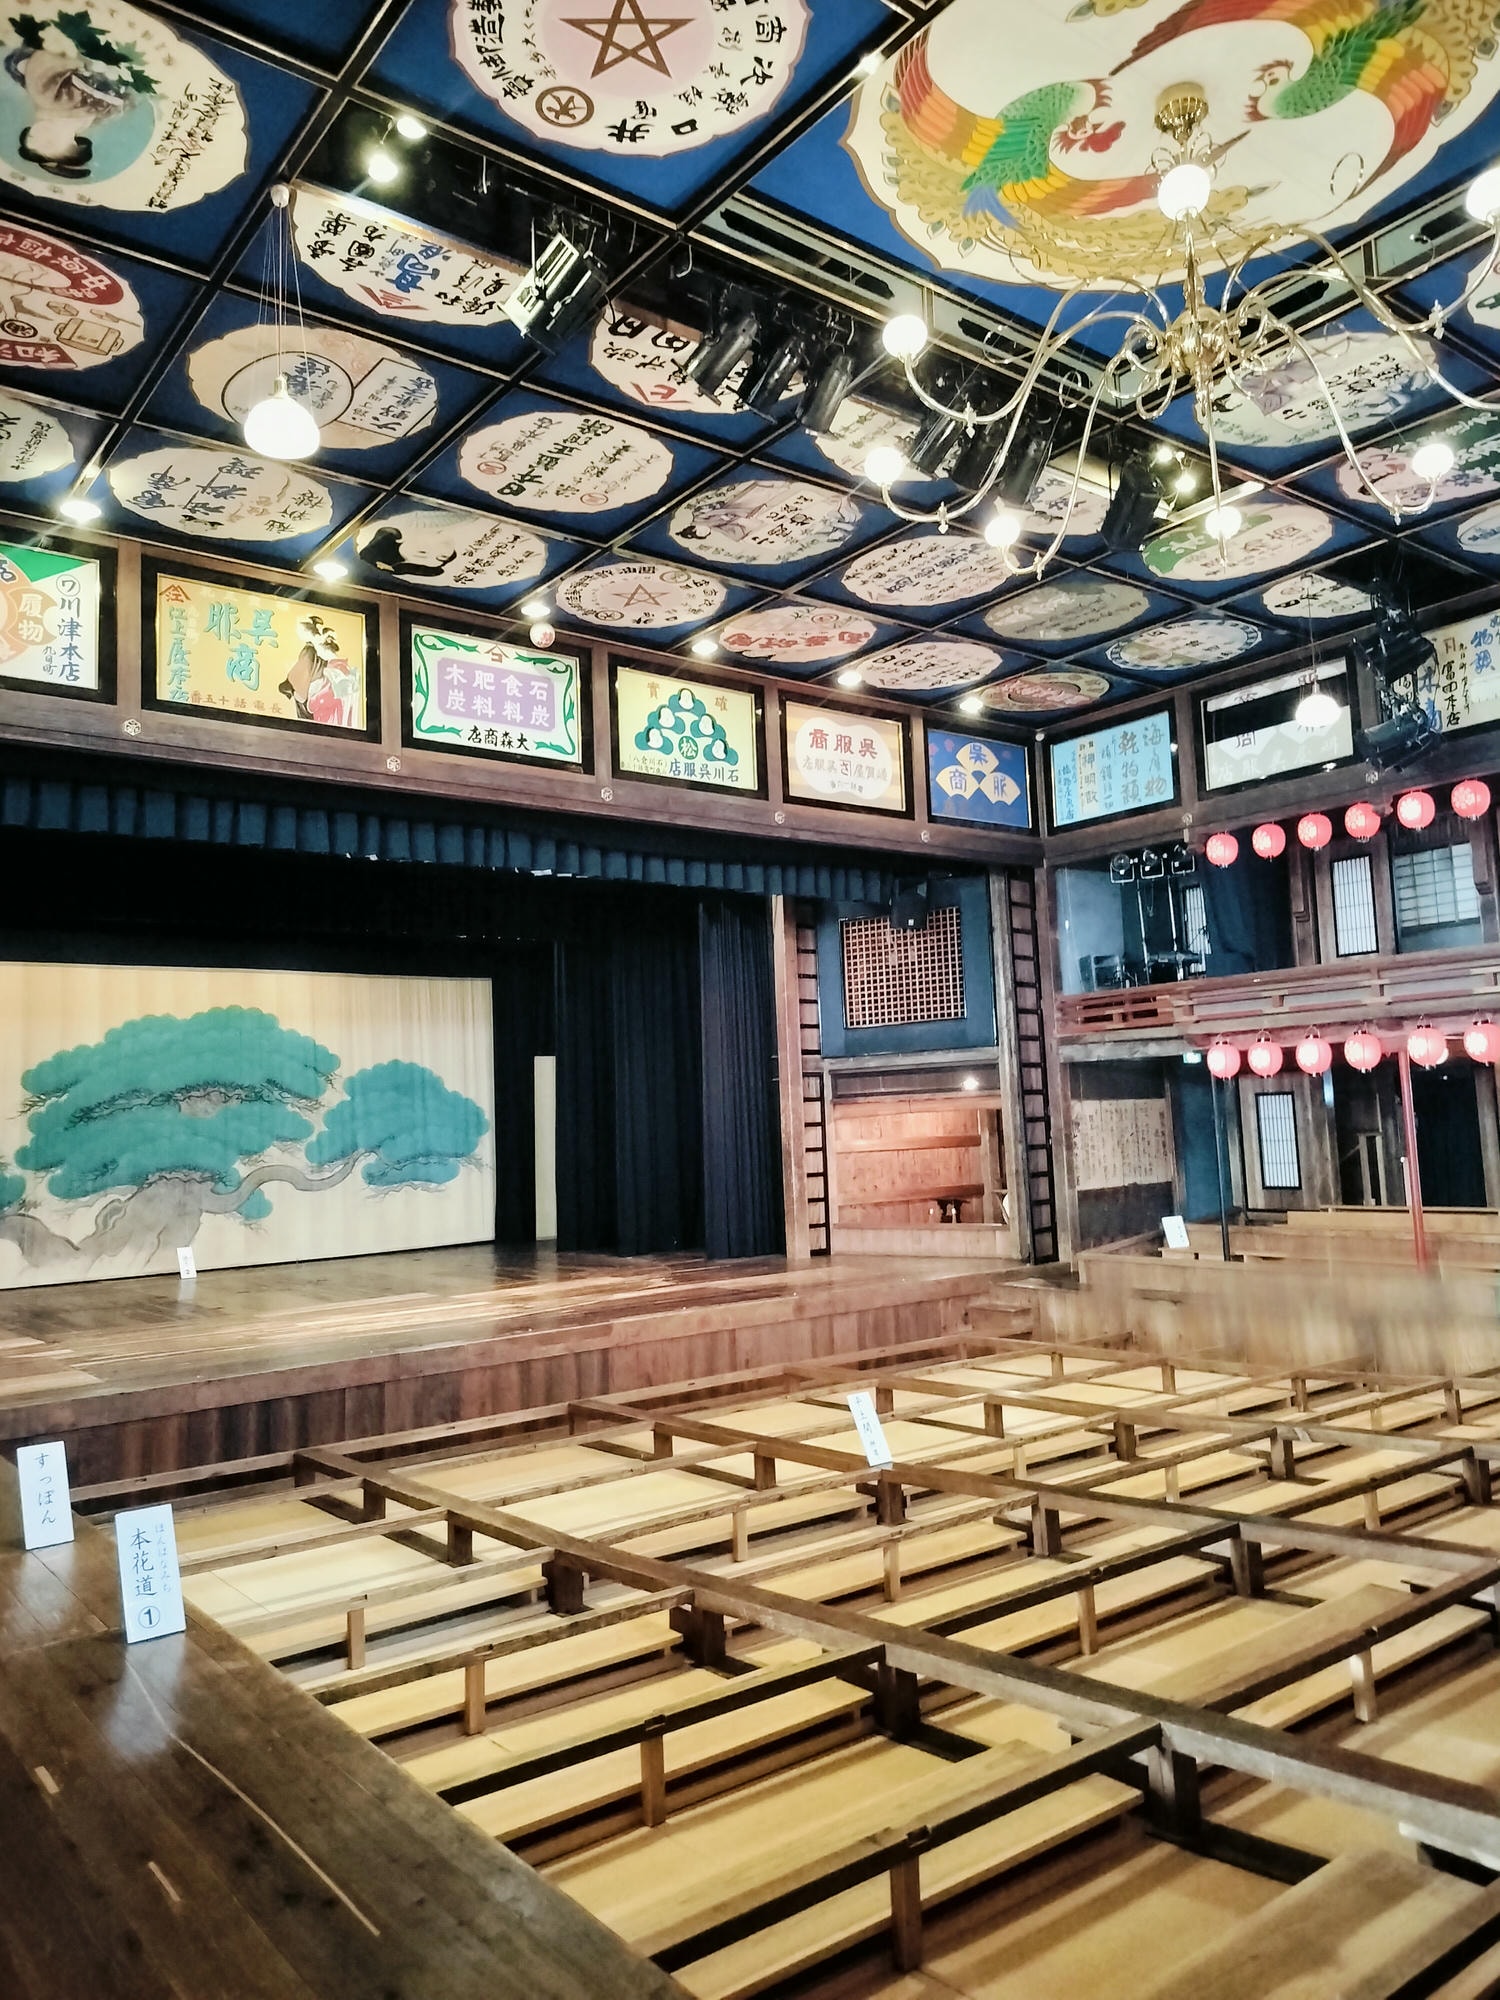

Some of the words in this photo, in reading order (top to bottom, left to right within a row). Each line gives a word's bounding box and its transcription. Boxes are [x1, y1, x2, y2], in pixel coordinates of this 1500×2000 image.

[18, 593, 44, 642] 履物
[58, 597, 84, 682] 川津本店
[444, 664, 467, 712] 木炭
[472, 669, 496, 718] 肥料
[501, 675, 524, 724] 食料
[529, 680, 550, 728] 石炭
[35, 1451, 56, 1525] すっぽん
[130, 1528, 157, 1597] 本花道
